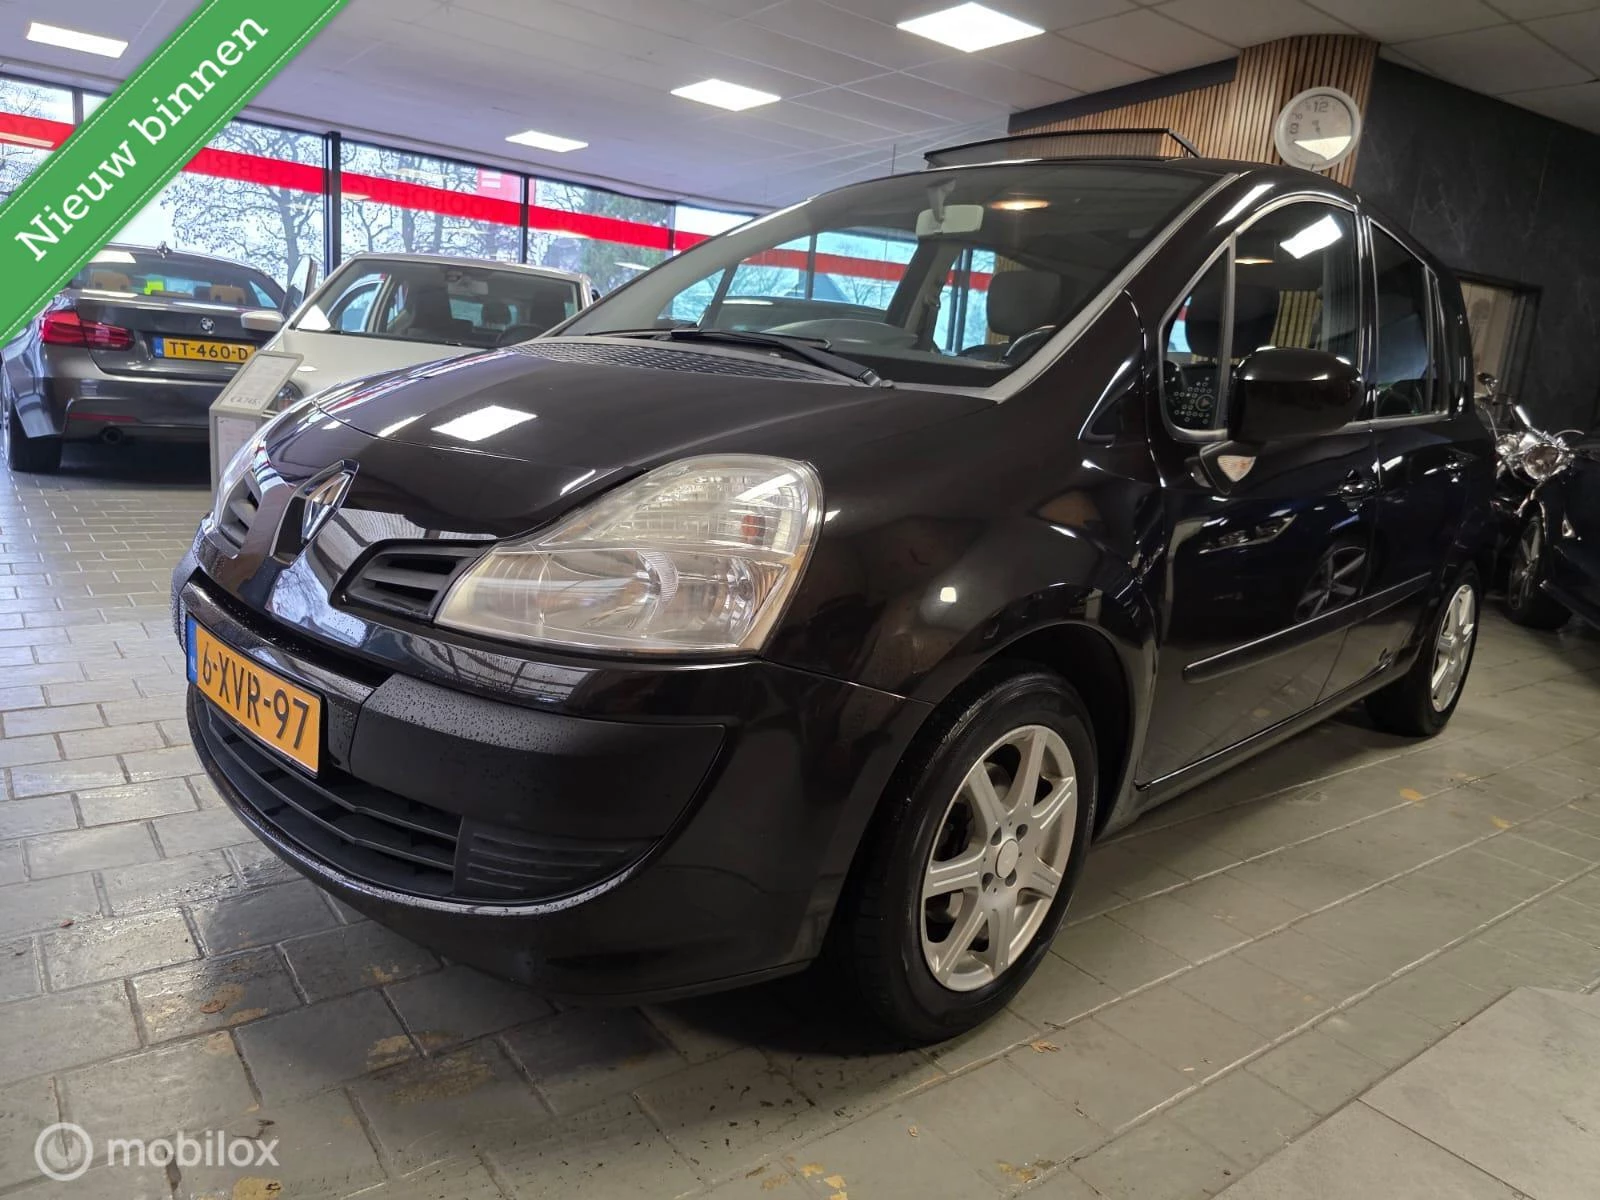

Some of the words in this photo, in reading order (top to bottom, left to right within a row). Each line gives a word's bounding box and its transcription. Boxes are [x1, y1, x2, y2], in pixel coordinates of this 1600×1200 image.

[1313, 100, 1329, 113] 12
[168, 341, 248, 359] TT-460-D
[202, 641, 310, 750] 6-XVR-97
